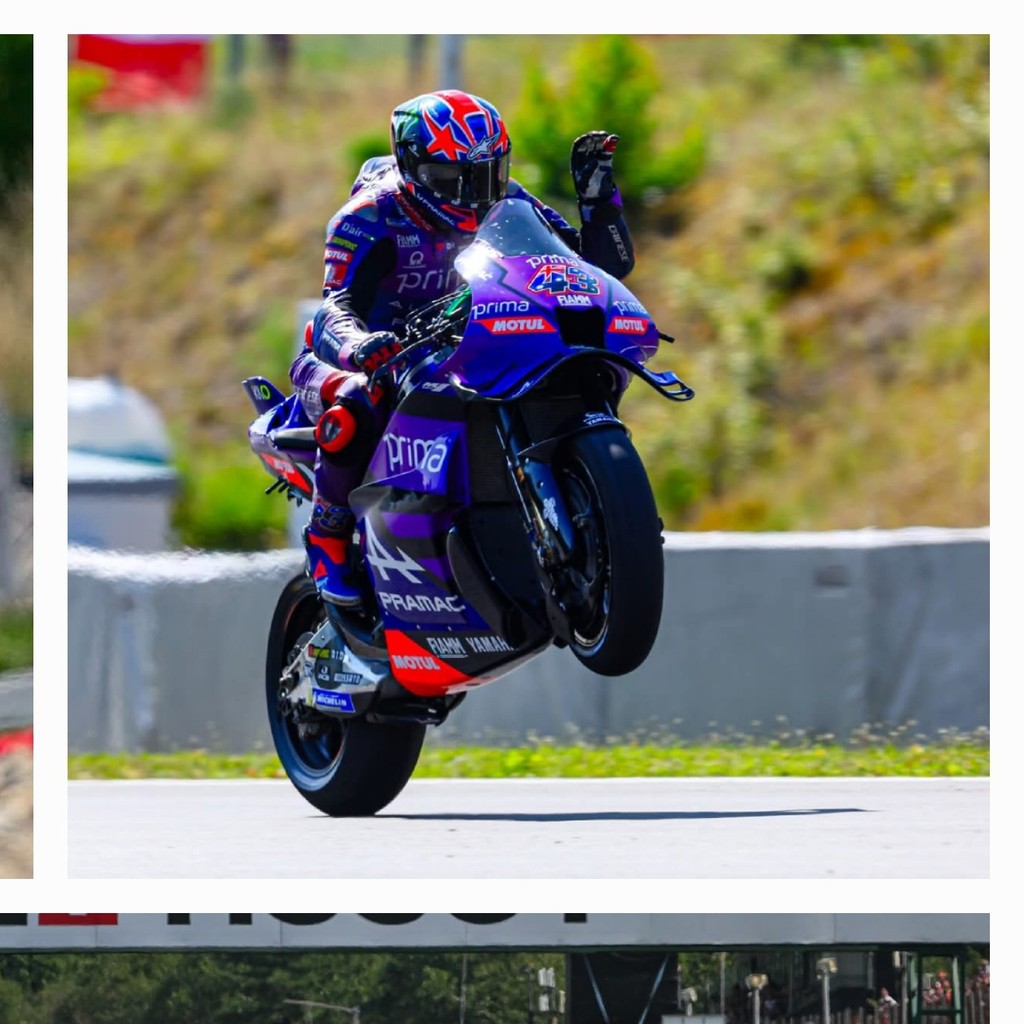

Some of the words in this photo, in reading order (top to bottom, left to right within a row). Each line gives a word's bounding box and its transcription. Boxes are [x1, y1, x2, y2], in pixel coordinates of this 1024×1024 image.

[396, 233, 421, 248] FIAMM
[396, 268, 462, 295] pri
[526, 263, 601, 296] 43
[471, 299, 530, 320] prima
[556, 294, 592, 307] FIAMM
[492, 317, 545, 333] MOTUL
[614, 317, 645, 332] MOTUL
[383, 432, 449, 473] prima
[379, 591, 467, 614] PRAMAC
[426, 636, 469, 658] FIAMM
[465, 635, 515, 653] YAMAH
[392, 654, 441, 671] MOTUL
[317, 694, 348, 707] MICHELIN
